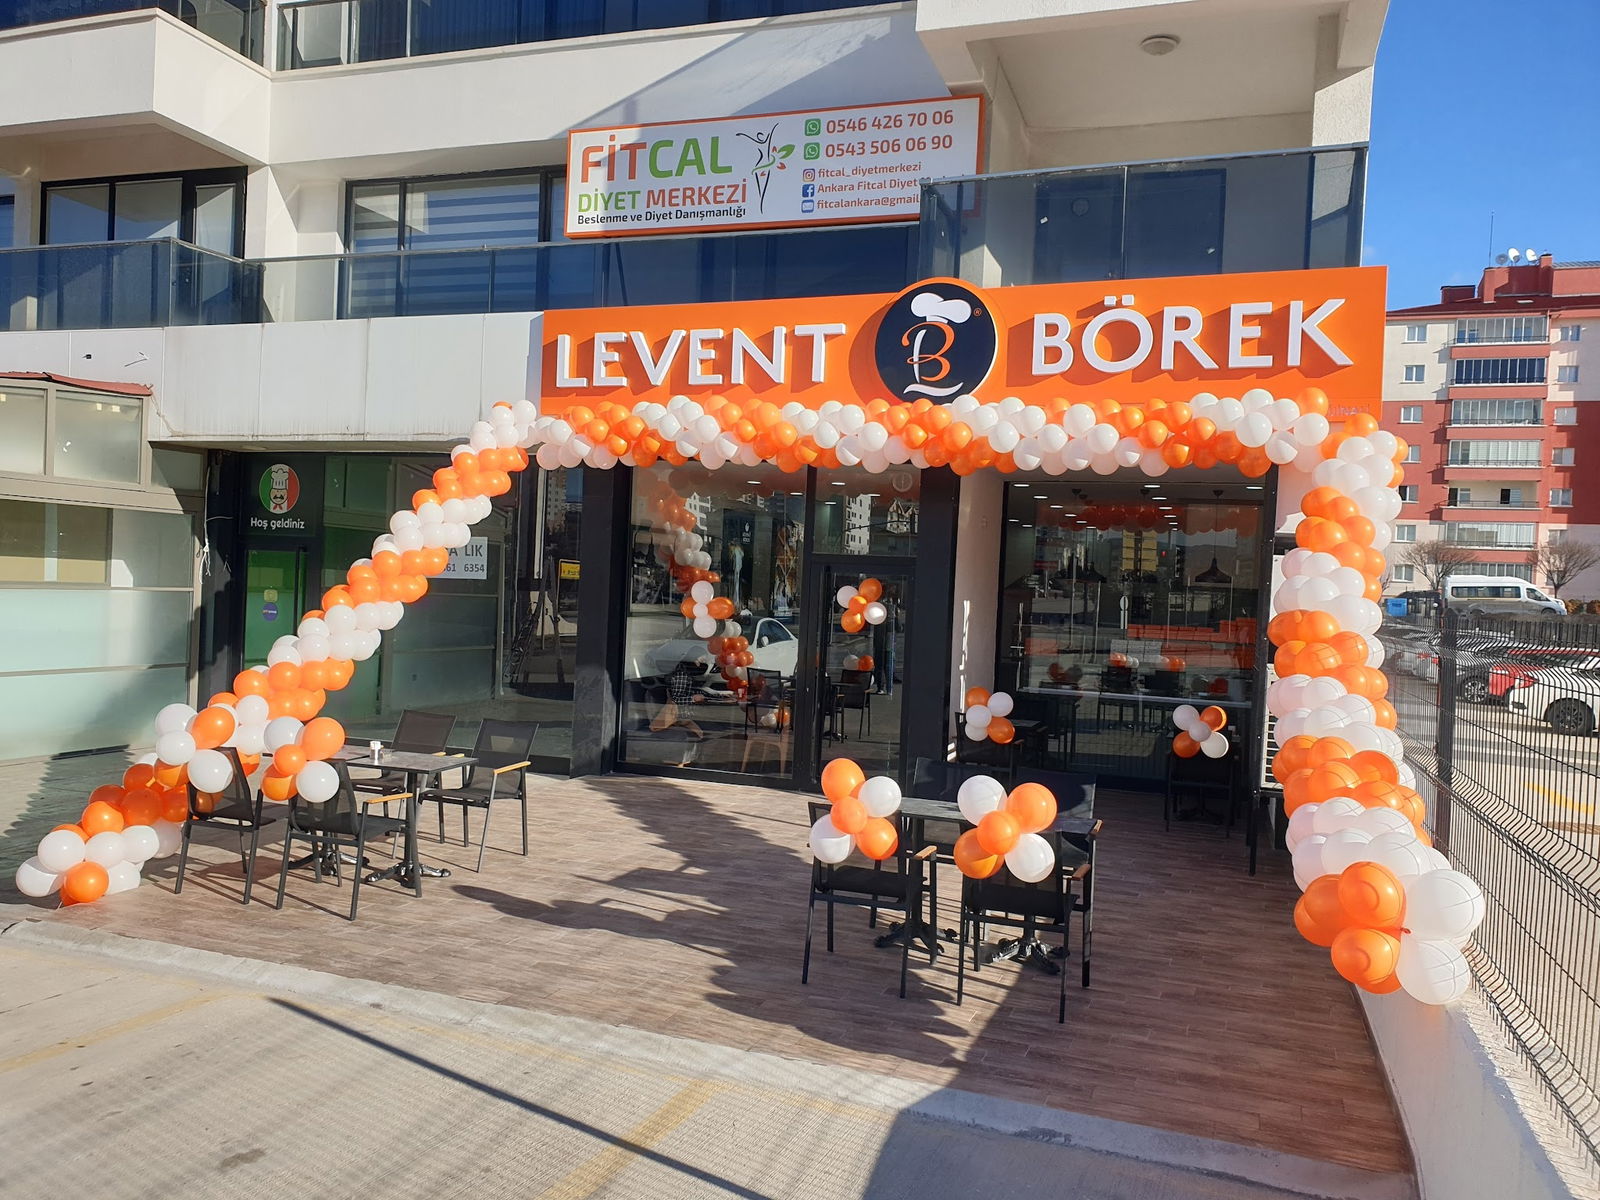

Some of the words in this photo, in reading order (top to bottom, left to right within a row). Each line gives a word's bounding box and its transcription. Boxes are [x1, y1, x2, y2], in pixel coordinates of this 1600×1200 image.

[826, 117, 868, 135] 0546
[871, 114, 903, 130] 426
[906, 112, 927, 127] 70
[932, 110, 953, 125] 06
[825, 141, 866, 158] 0543
[870, 138, 901, 154] 506
[905, 136, 927, 151] 06
[931, 134, 953, 149] 90
[580, 134, 733, 184] FİTCAL
[818, 161, 922, 178] fitcal_diyetmerkezi
[578, 188, 641, 213] DİYET
[646, 178, 747, 208] MERKEZİ
[817, 182, 855, 193] Ankara
[857, 179, 887, 190] Fitcal
[889, 177, 918, 190] Diyet
[577, 213, 628, 225] Beslenme
[630, 214, 643, 222] ve
[645, 211, 673, 223] Diyet
[675, 206, 746, 221] Danışmanlığı
[1030, 294, 1356, 378] BÖREK
[554, 322, 848, 390] LEVENT
[250, 517, 268, 530] Hoş
[270, 518, 305, 530] geldiniz
[464, 563, 485, 573] 6354
